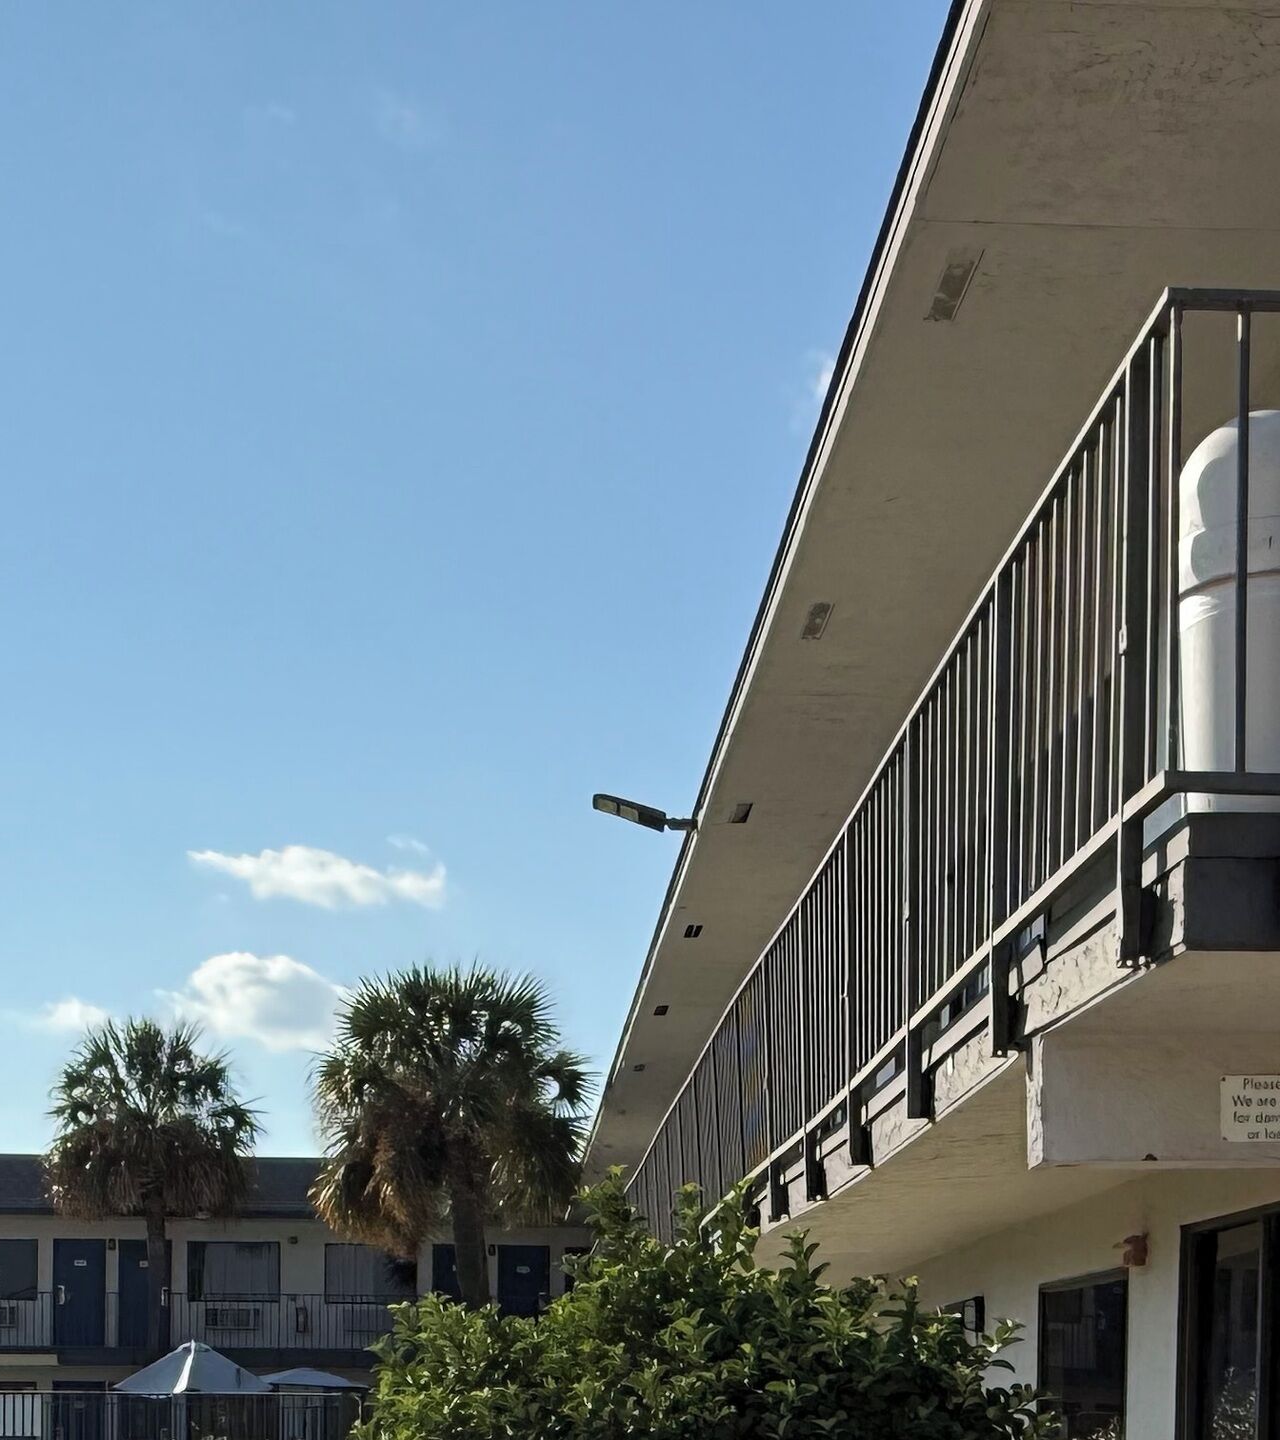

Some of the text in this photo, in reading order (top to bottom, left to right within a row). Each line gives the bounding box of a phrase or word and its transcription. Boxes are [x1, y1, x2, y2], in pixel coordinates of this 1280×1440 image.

[1232, 1095, 1253, 1107] We
[1257, 1097, 1277, 1107] are
[1233, 1111, 1250, 1123] for
[1247, 1130, 1261, 1140] or
